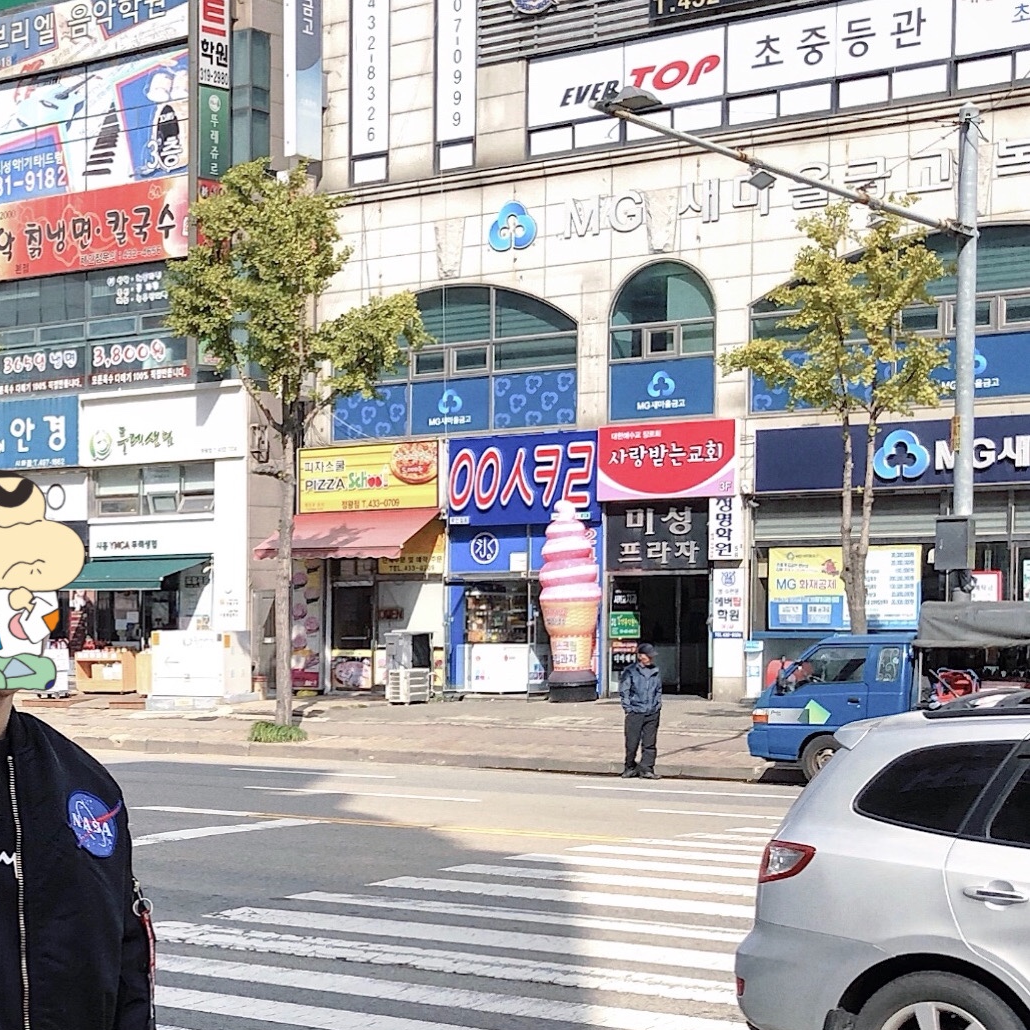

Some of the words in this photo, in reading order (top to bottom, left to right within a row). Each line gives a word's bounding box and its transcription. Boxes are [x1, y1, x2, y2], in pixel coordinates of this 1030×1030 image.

[68, 0, 167, 38] 음악학원
[751, 7, 927, 70] 초중등관
[201, 39, 228, 68] 학원
[560, 79, 620, 107] EVER
[630, 55, 720, 91] TOP
[147, 139, 182, 169] 3층
[564, 190, 645, 241] MG
[10, 414, 67, 453] 안경
[305, 460, 345, 473] 피자스쿨
[305, 479, 345, 491] PIZZA
[720, 482, 731, 491] 3F
[625, 506, 693, 536] 미성
[110, 541, 131, 550] YMCA
[618, 540, 700, 566] 프라자
[776, 579, 796, 590] MG
[718, 609, 739, 621] 학원
[71, 812, 113, 838] NASA
